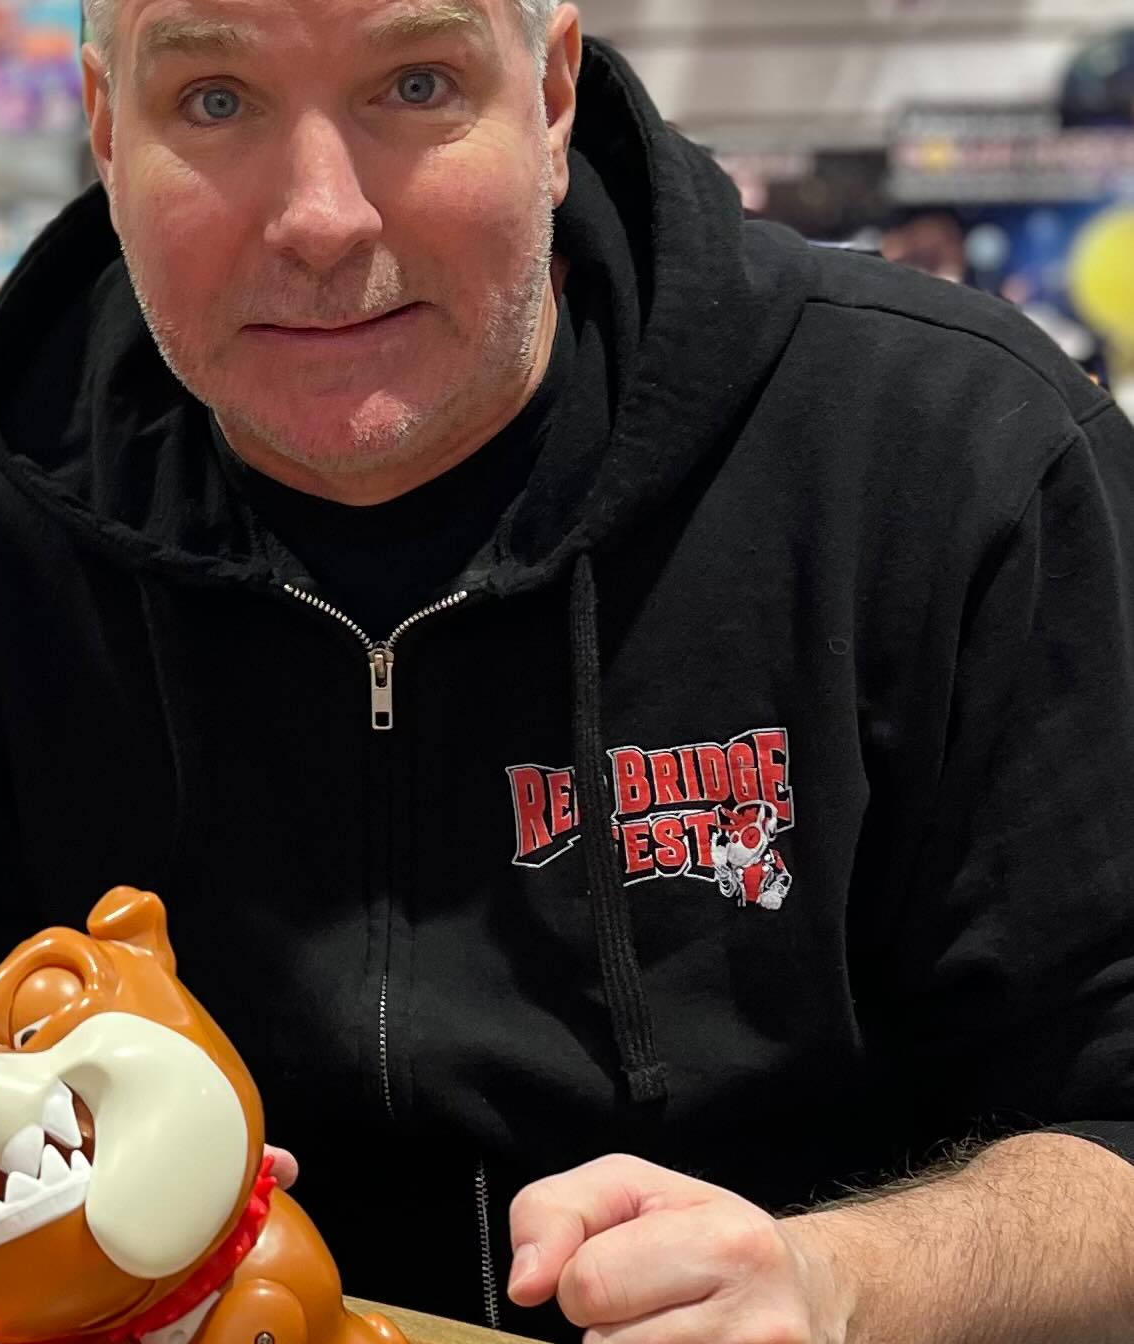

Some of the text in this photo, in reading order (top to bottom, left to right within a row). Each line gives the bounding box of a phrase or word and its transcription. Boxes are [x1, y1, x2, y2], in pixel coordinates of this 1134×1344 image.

[512, 730, 792, 858] RE BRIDGE
[612, 810, 718, 874] EST
